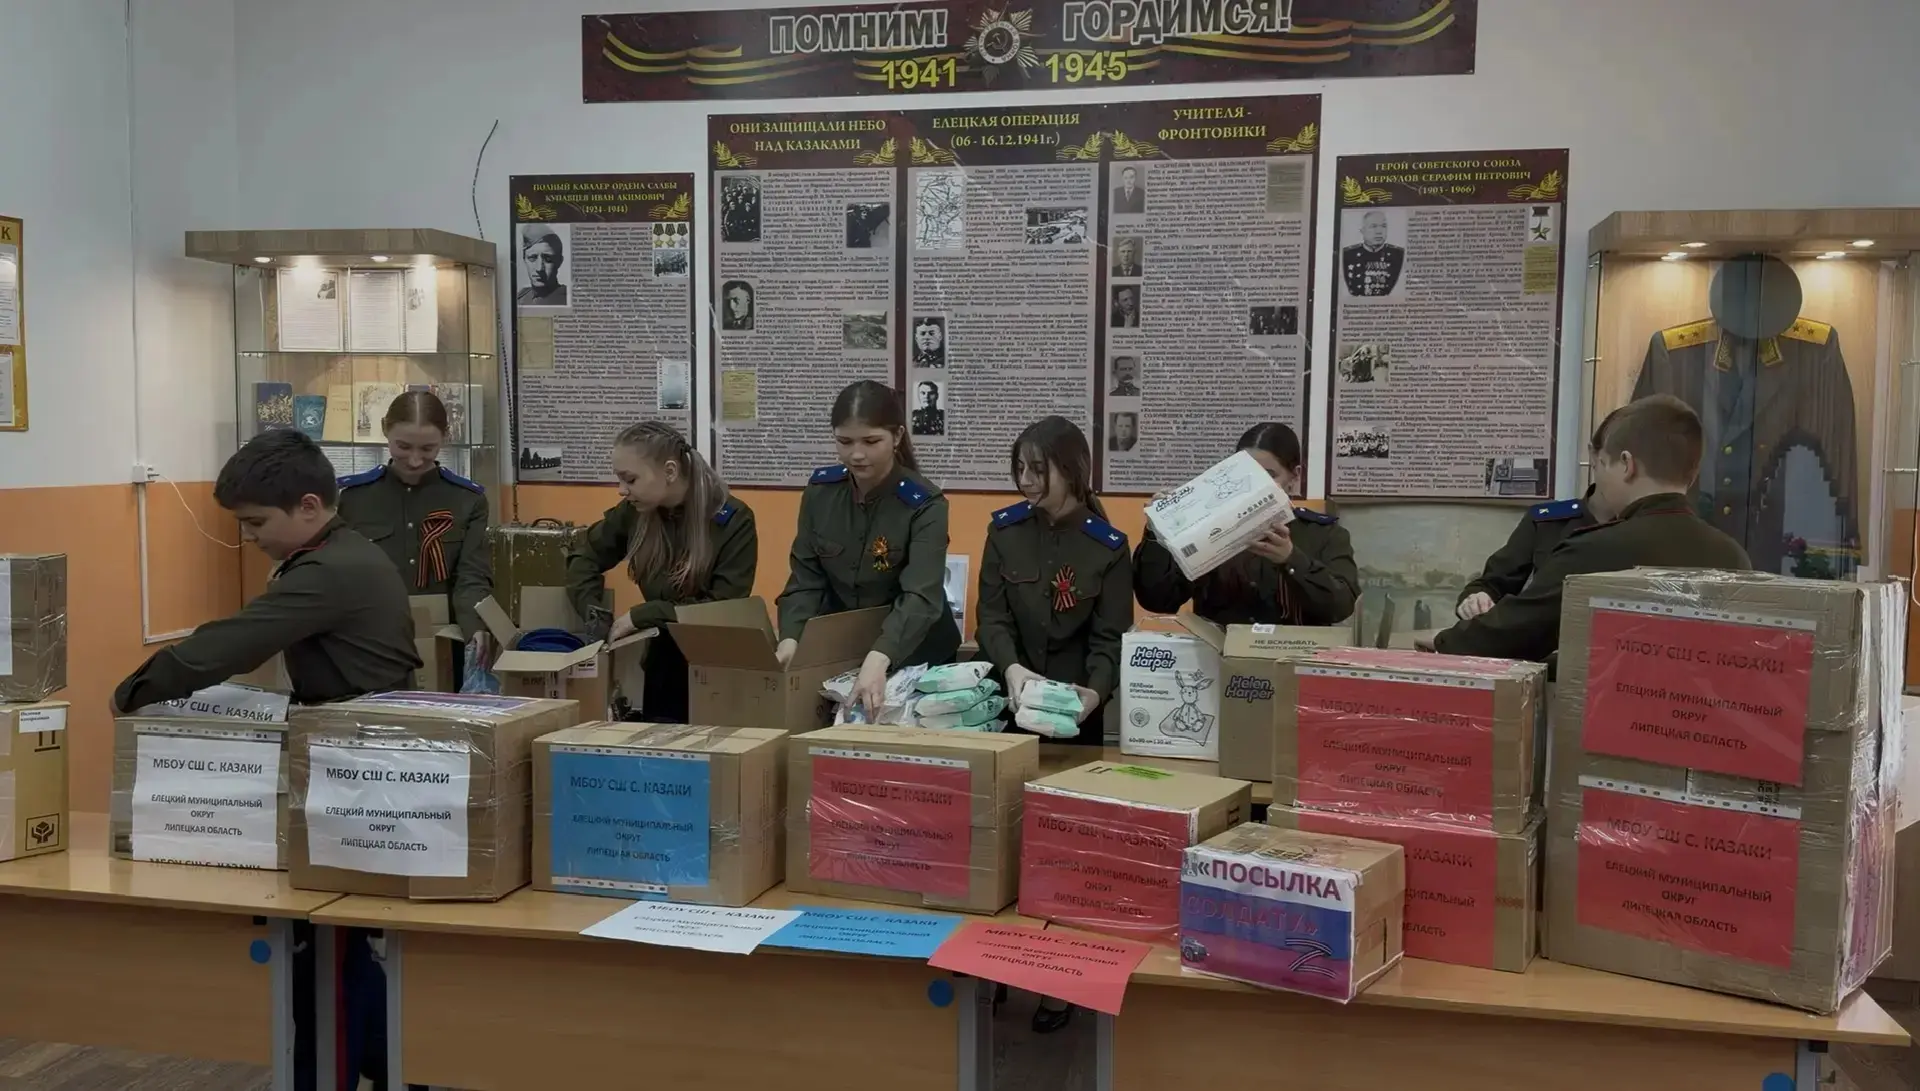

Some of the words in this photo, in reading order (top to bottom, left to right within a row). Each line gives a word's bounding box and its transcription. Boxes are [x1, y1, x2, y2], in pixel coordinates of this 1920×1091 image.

[769, 8, 948, 54] ПОМНИМ!
[1062, 0, 1292, 45] ГОРДИМСЯ!
[879, 57, 957, 90] 1941
[1043, 52, 1128, 84] 1945
[1172, 106, 1244, 120] УЧИТЕЛЯ
[730, 123, 761, 134] ОНИ
[764, 120, 846, 134] ЗАЩИЩАЛИ
[848, 119, 887, 131] НЕБО
[932, 116, 998, 131] ЕЛЕЦКАЯ
[1001, 113, 1081, 128] ОПЕРАЦИЯ
[1157, 124, 1267, 141] ФРОНТОВИКИ
[755, 140, 784, 153] НАД
[786, 138, 861, 151] КАЗАКАМИ
[950, 134, 971, 149] (06
[1374, 160, 1409, 171] ГЕРОЙ
[1411, 159, 1480, 170] СОВЕТСКОГО
[1483, 158, 1522, 169] СОЮЗА
[1364, 173, 1419, 184] МЕРКУЛОВ
[1421, 172, 1472, 182] СЕРАФИМ
[1474, 171, 1532, 181] ПЕТРОВИЧ
[532, 183, 571, 192] ПОЛНЫЙ
[572, 182, 610, 191] КАВАЛЕР
[611, 182, 645, 191] ОРДЕНА
[647, 182, 678, 190] СЛАВЫ
[591, 193, 615, 202] ИВАН
[616, 192, 665, 202] АКИМОВИЧ
[1134, 646, 1173, 661] Helen
[1615, 638, 1664, 657] МБОУ
[1666, 646, 1692, 662] СШ
[1696, 651, 1710, 664] С.
[1716, 653, 1785, 674] КАЗАКИ
[1130, 655, 1175, 672] Harper
[1229, 675, 1272, 690] Helen
[1224, 686, 1275, 703] Harper
[1616, 682, 1666, 699] ЕЛЕЦКИЙ
[1669, 690, 1784, 717] МУНИЦИПАЛЬНЫЙ
[190, 701, 210, 713] СШ
[212, 705, 222, 715] С.
[225, 706, 274, 722] КАЗАКИ
[1671, 709, 1708, 723] ОКРУГ
[1629, 721, 1691, 740] ЛИПЕЦКАЯ
[1693, 731, 1748, 751] ОБЛАСТЬ
[153, 758, 186, 770] МБОУ
[188, 760, 205, 771] СШ
[207, 762, 218, 772] С.
[219, 762, 263, 774] КАЗАКИ
[326, 767, 359, 780] МБОУ
[362, 769, 382, 781] СШ
[386, 771, 397, 782] С.
[399, 771, 450, 784] КАЗАКИ
[570, 776, 603, 789] МБОУ
[607, 781, 627, 792] СШ
[630, 782, 640, 793] С.
[643, 783, 692, 797] КАЗАКИ
[151, 793, 186, 804] ЕЛЕЦКИЙ
[187, 796, 263, 808] МУНИЦИПАЛЬНЫЙ
[190, 810, 215, 819] ОКРУГ
[325, 806, 364, 818] ЕЛЕЦКИЙ
[366, 808, 452, 821] МУНИЦИПАЛЬНЫЙ
[164, 823, 206, 834] ЛИПЕЦКАЯ
[207, 826, 243, 836] ОБЛАСТЬ
[368, 823, 396, 833] ОКРУГ
[1038, 816, 1074, 833] МБОУ
[340, 838, 386, 850] ЛИПЕЦКАЯ
[387, 840, 428, 852] ОБЛАСТЬ
[1606, 815, 1652, 834] МБОУ
[1656, 827, 1680, 845] СШ
[1684, 833, 1699, 848] С.
[1704, 836, 1773, 861] КАЗАКИ
[1413, 848, 1473, 868] КАЗАКИ
[1197, 859, 1343, 901] «ПОСЫЛКА
[1658, 872, 1772, 904] МУНИЦИПАЛЬНЫЙ
[1661, 890, 1696, 905] ОКРУГ
[1683, 916, 1738, 934] ОБЛАСТЬ
